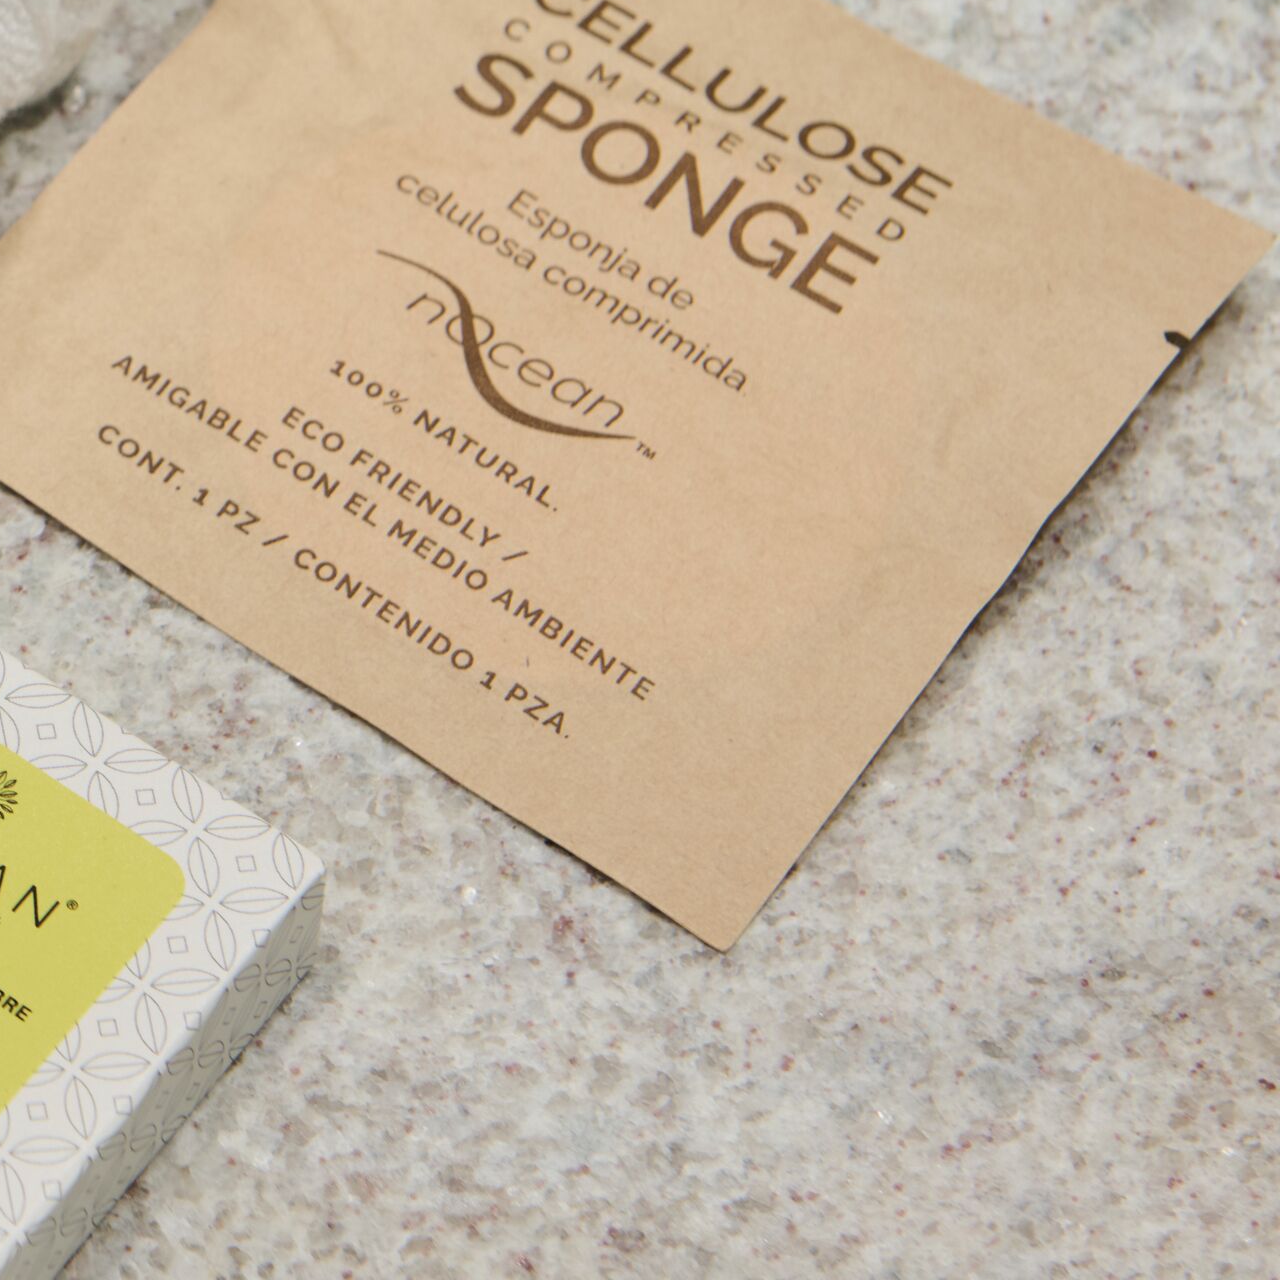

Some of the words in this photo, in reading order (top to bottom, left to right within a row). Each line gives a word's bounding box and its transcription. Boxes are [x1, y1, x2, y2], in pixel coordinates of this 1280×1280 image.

[395, 173, 537, 272] celulosa
[453, 52, 880, 315] SPONGE
[504, 18, 906, 243] COMPRESSED
[506, 189, 642, 284] Esponja
[647, 276, 694, 310] de
[112, 355, 269, 453] AMIGABLE
[272, 448, 340, 499] CON
[344, 493, 379, 527] EL
[387, 519, 488, 591] MEDIO
[492, 589, 656, 702] AMBIENTE
[280, 407, 345, 454] ECO
[350, 452, 502, 549] FRIENDLY
[329, 359, 411, 416] 100%
[413, 409, 559, 513] NATURAL.
[98, 424, 184, 492] CONT.
[192, 487, 211, 507] 1
[216, 500, 259, 536] PZ
[293, 549, 475, 673] CONTENIDO
[480, 670, 499, 691] 1
[505, 683, 570, 739] PZA.
